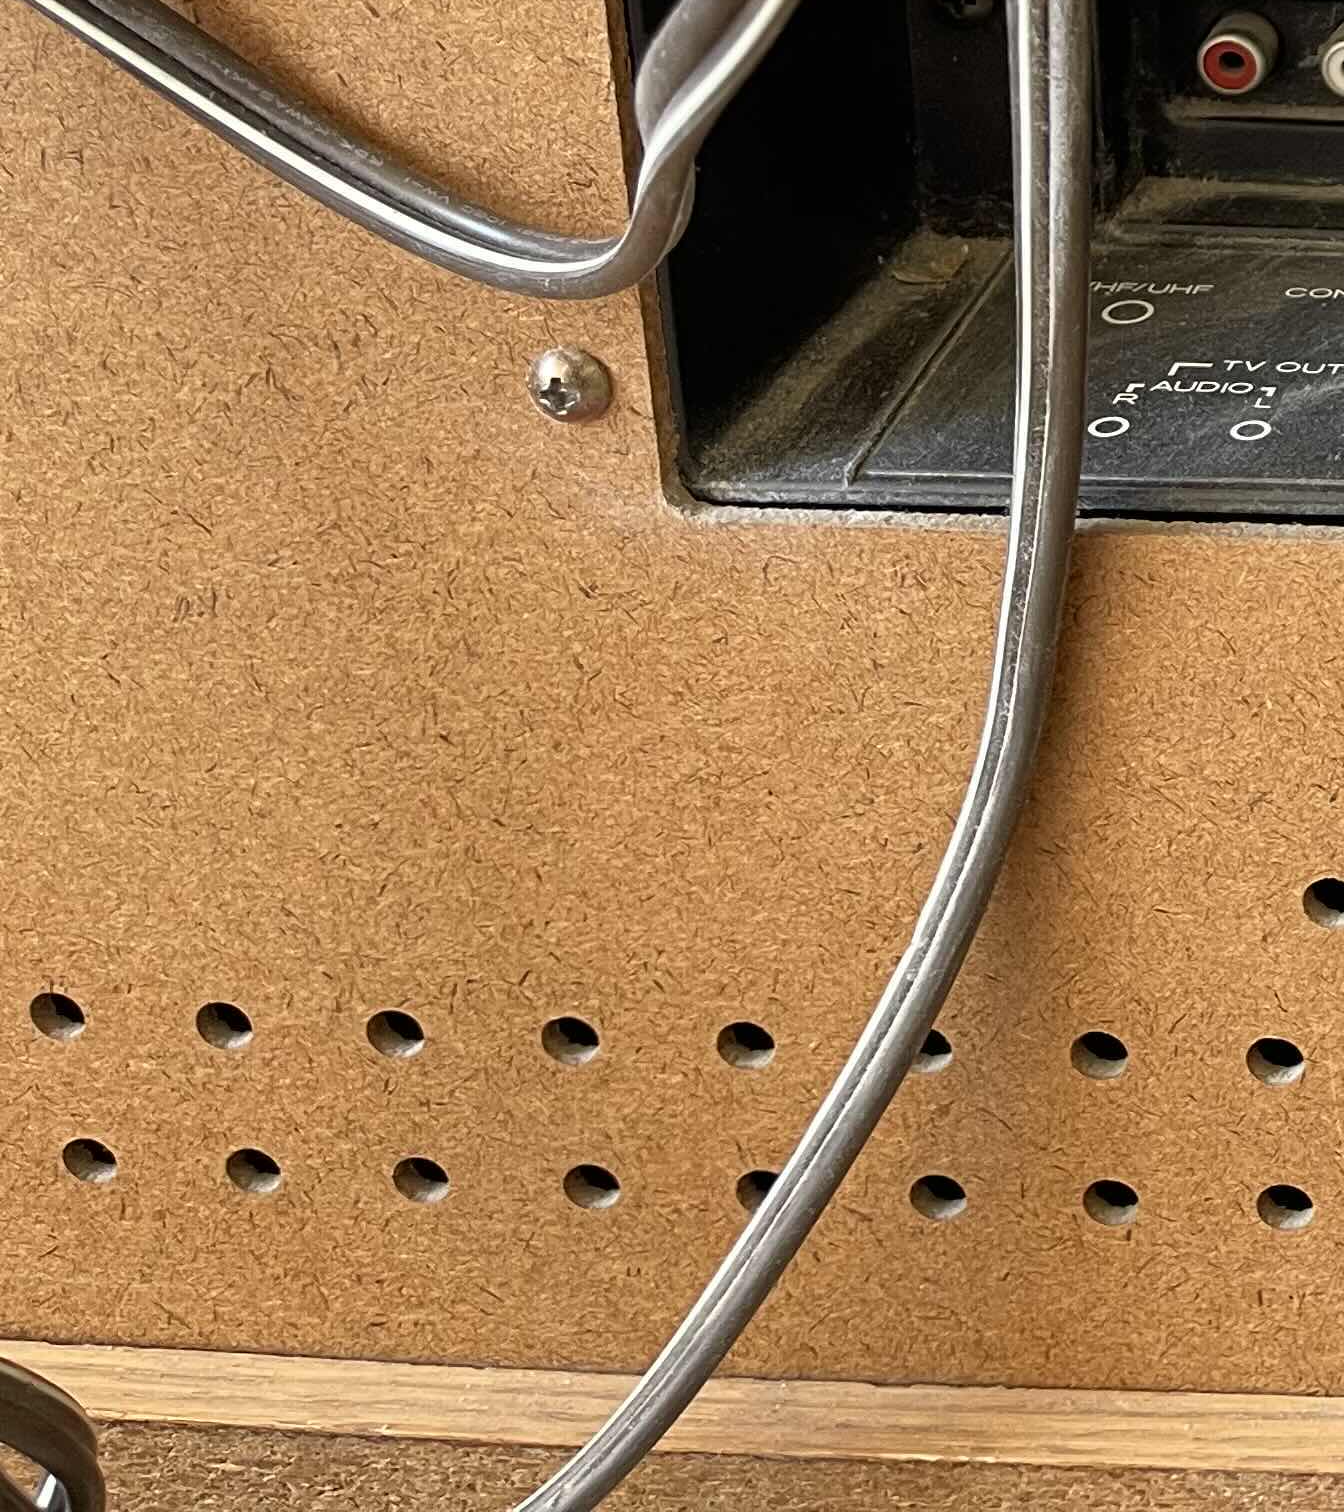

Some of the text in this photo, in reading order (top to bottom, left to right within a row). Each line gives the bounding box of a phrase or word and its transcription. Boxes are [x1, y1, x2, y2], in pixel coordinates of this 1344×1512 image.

[1223, 359, 1267, 373] TV
[1148, 380, 1255, 395] AUDIO
[1112, 392, 1272, 409] R L
